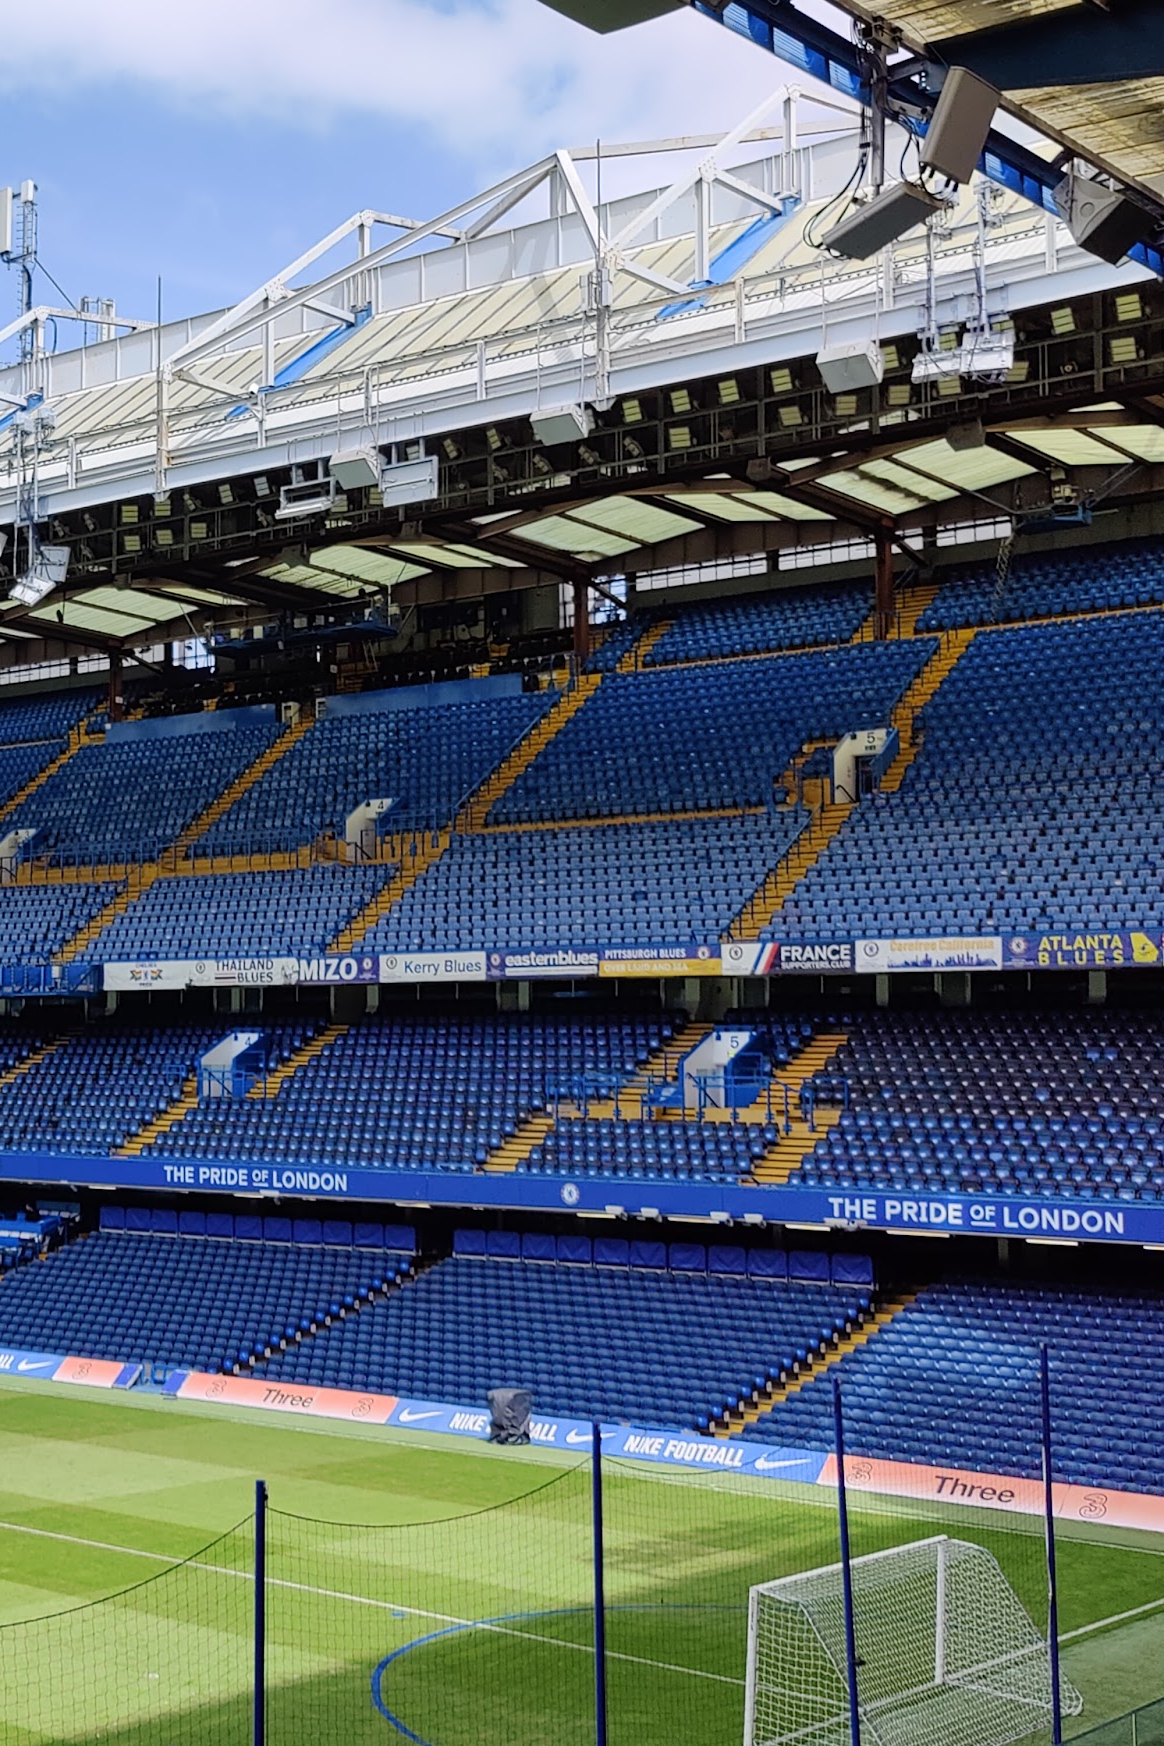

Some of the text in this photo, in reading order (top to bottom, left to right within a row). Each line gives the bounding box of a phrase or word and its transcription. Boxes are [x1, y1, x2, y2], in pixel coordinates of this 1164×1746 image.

[867, 732, 875, 744] 5
[377, 800, 384, 810] 4
[890, 938, 995, 952] Carefree California
[1038, 934, 1123, 950] ATLANTA
[505, 950, 599, 967] easternblues
[604, 947, 686, 961] PITTSBURGH BLUES
[780, 944, 851, 961] FRANCE
[1038, 949, 1124, 966] BLUES
[214, 960, 274, 972] THAILAND
[299, 957, 358, 981] MIZO
[404, 958, 482, 977] Kerry Blues
[603, 961, 628, 973] OVER
[652, 961, 672, 971] AND
[237, 972, 274, 983] BLUES
[244, 1036, 252, 1046] 4
[730, 1036, 739, 1049] 5
[163, 1165, 348, 1192] THE PRIDE OF LONDON
[828, 1197, 1125, 1235] THE PRIDE OF LONDON
[262, 1388, 313, 1408] Three
[448, 1412, 487, 1432] NIKE
[623, 1434, 744, 1468] NIKE FOOTBALL
[934, 1474, 1015, 1504] Three
